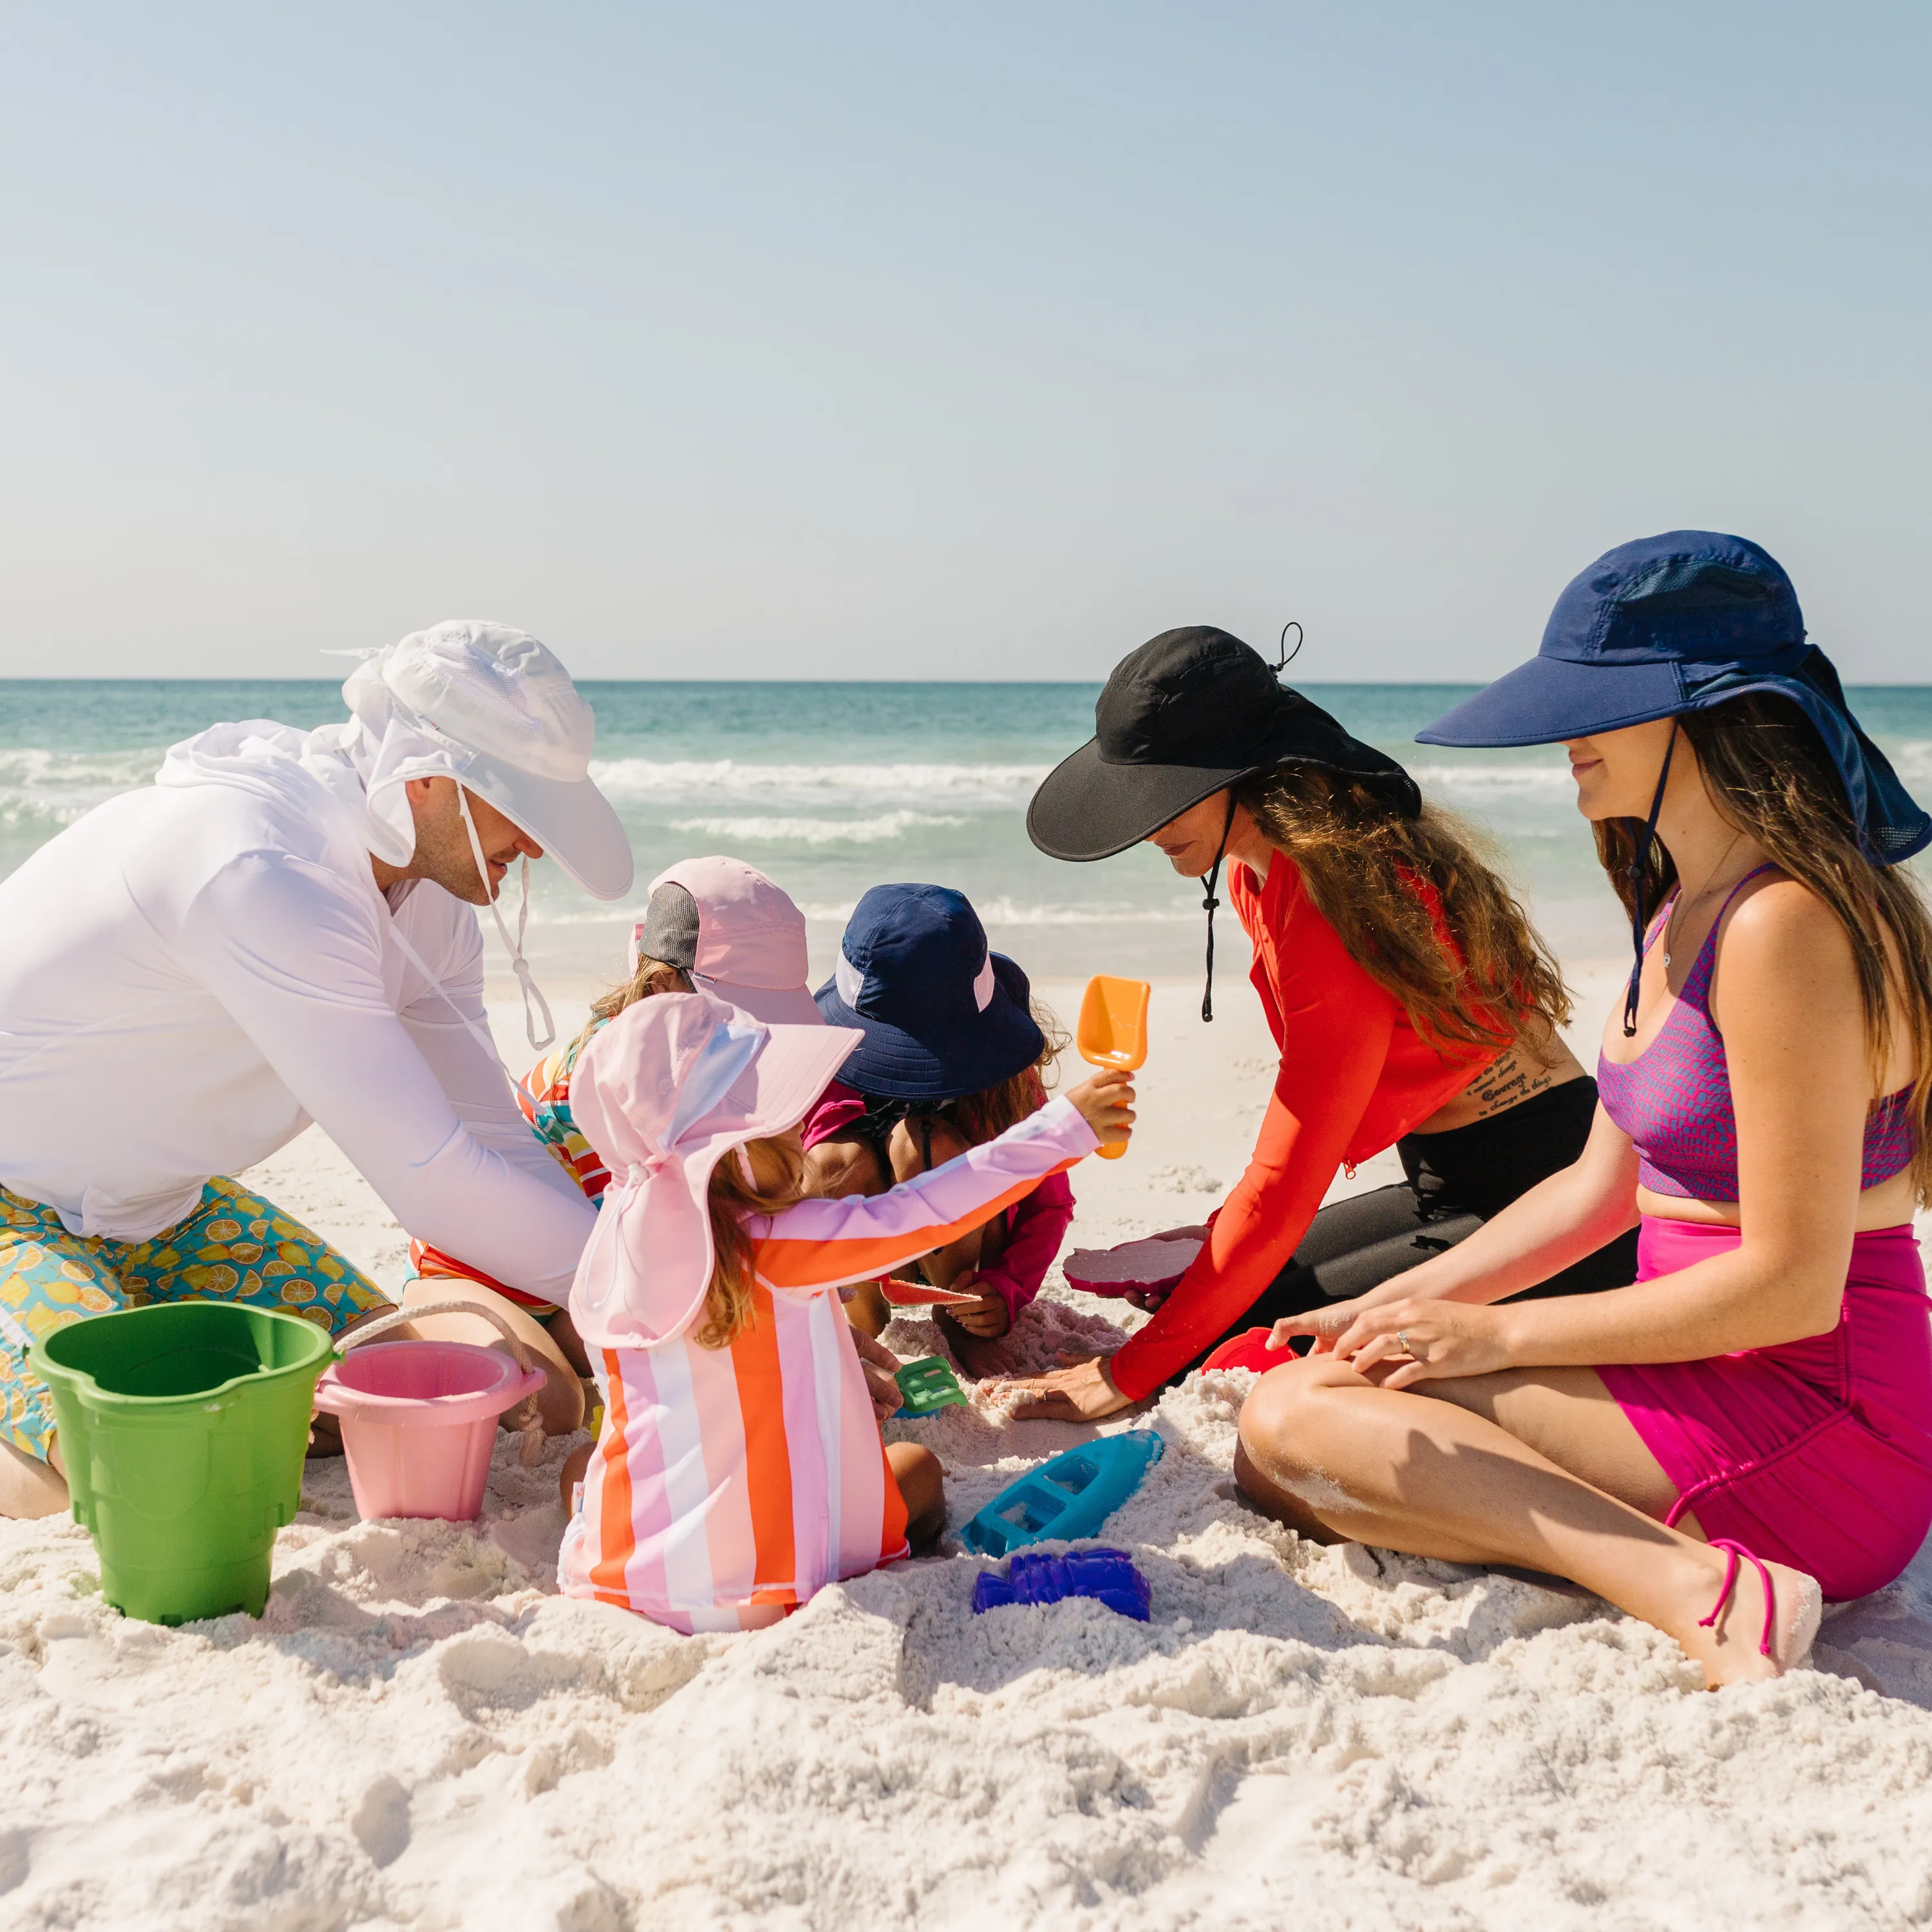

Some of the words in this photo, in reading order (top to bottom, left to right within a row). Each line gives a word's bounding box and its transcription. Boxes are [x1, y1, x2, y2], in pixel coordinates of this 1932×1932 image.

[1482, 1072, 1527, 1101] Courage
[1490, 1095, 1517, 1111] change
[1520, 1086, 1530, 1095] the
[1531, 1075, 1551, 1089] things
